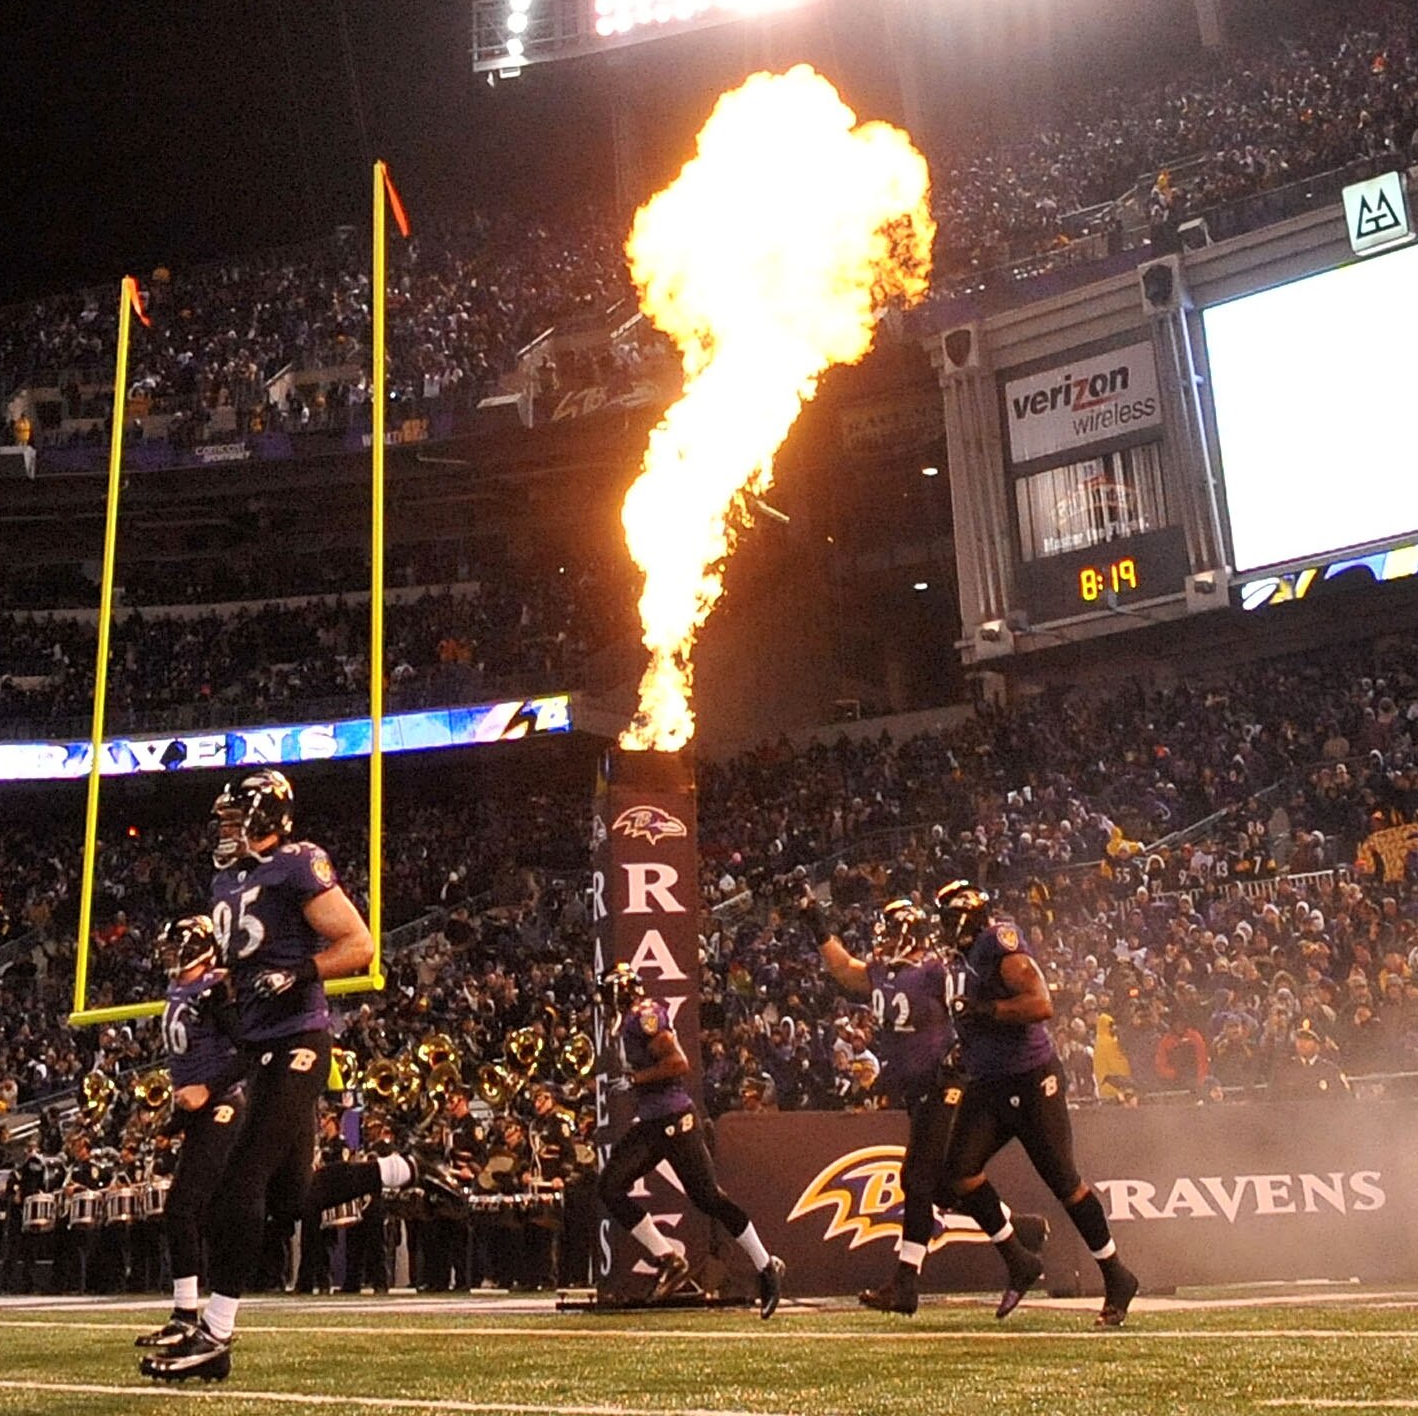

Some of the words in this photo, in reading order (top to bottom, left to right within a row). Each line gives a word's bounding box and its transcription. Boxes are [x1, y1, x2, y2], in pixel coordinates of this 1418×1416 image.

[1013, 365, 1130, 420] verizon
[1072, 397, 1157, 436] wireless
[1079, 558, 1138, 602] 8:19
[213, 885, 266, 969] 95
[871, 987, 917, 1032] 92
[1094, 1170, 1386, 1223] RAVENS
